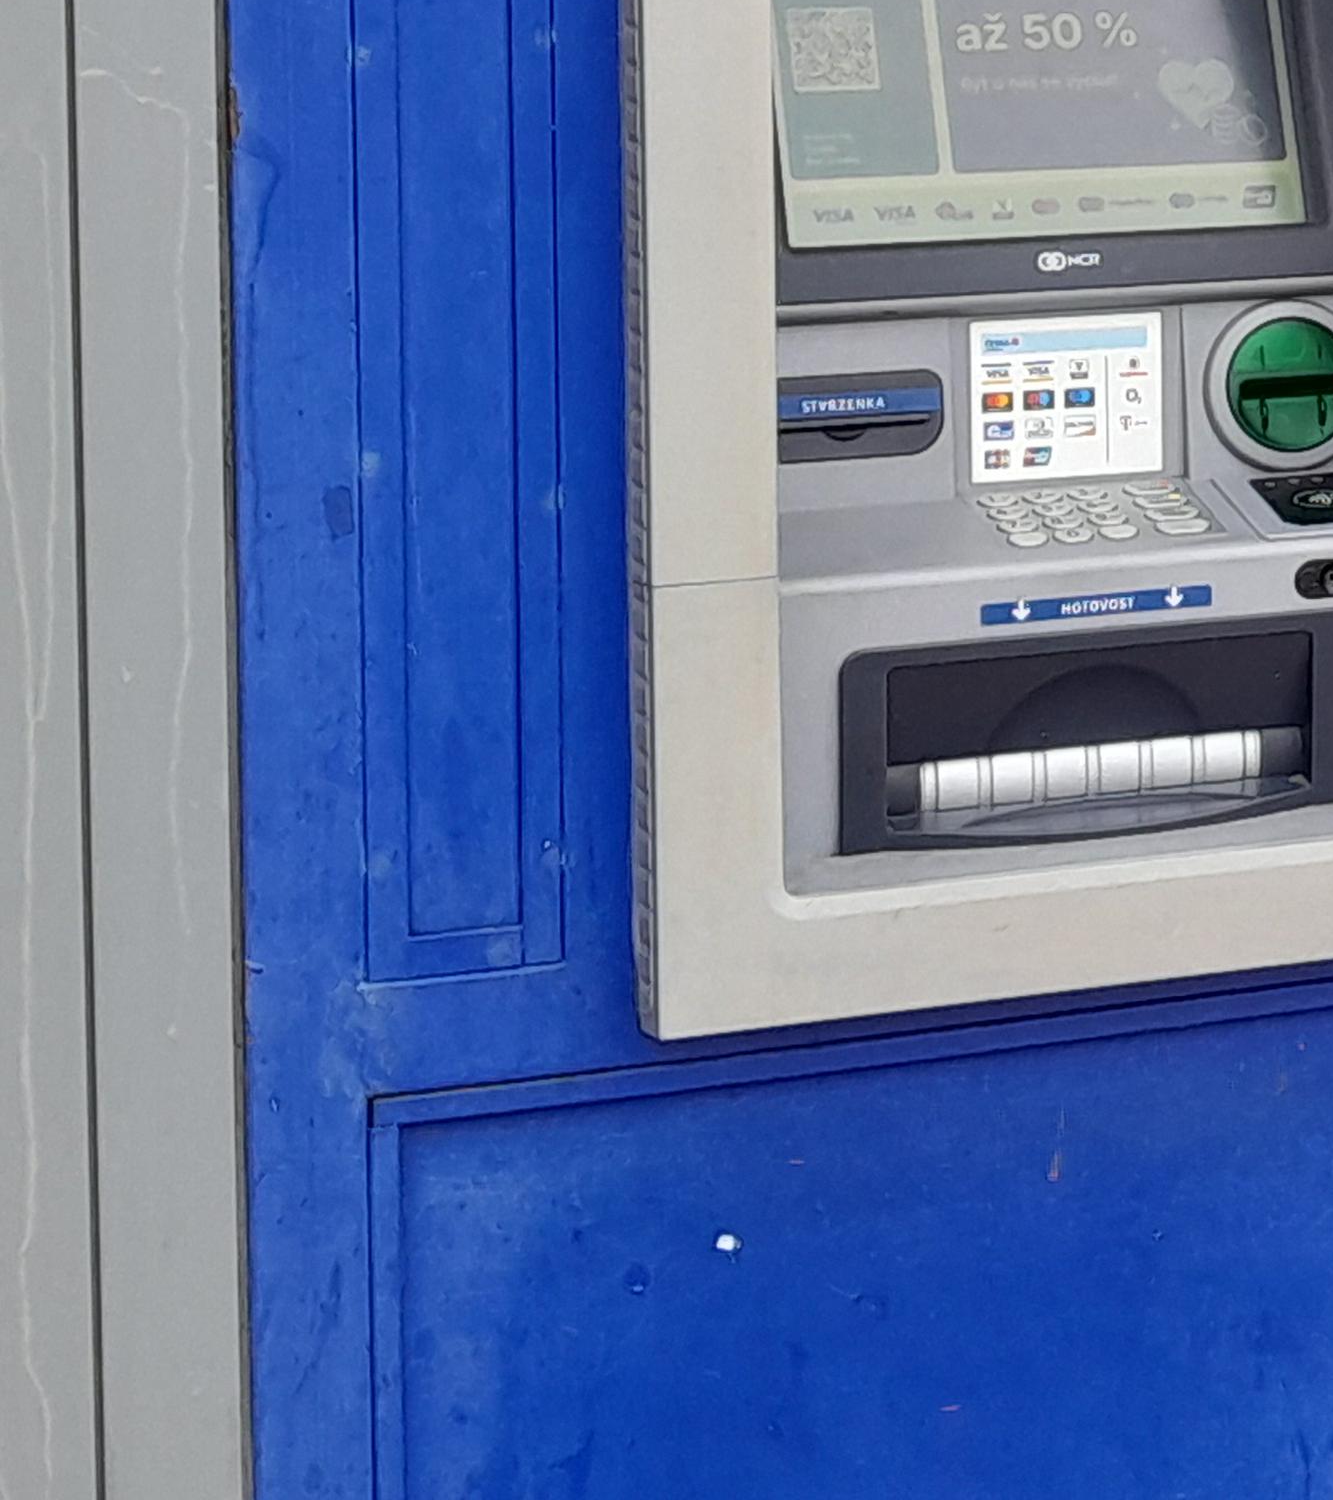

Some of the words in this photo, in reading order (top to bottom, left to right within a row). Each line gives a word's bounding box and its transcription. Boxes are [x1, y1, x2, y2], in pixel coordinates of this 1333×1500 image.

[956, 12, 1008, 51] až
[1023, 12, 1082, 50] 50
[1095, 11, 1137, 48] %
[801, 396, 886, 414] STVRZENKA
[1060, 595, 1136, 616] HOTOVOST
